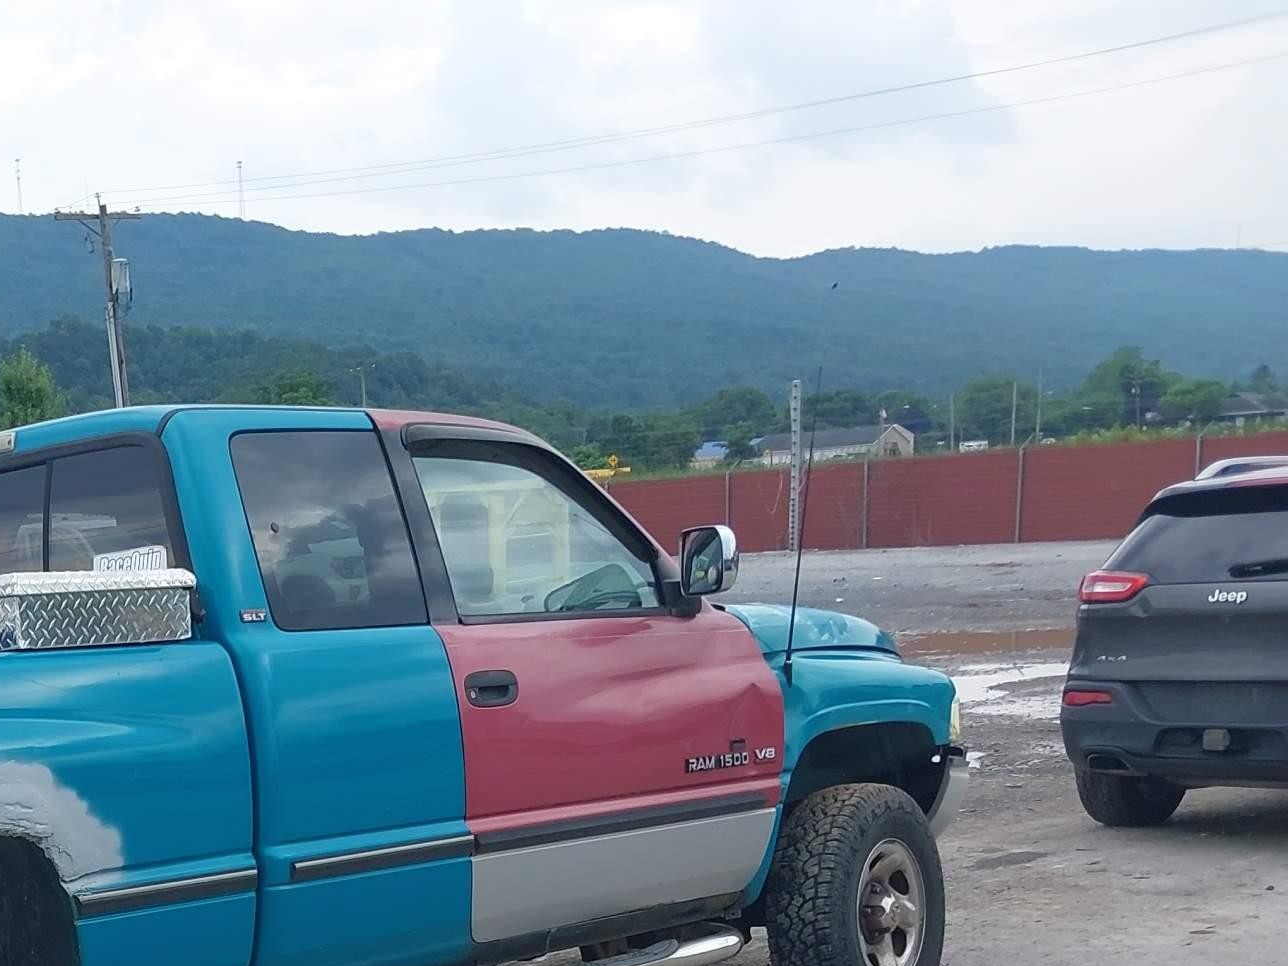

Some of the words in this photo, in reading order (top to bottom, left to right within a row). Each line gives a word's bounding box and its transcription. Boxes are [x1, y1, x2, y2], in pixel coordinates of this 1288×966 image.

[1208, 589, 1247, 604] Jeep
[243, 612, 267, 621] SLT
[688, 757, 716, 772] RAM
[720, 752, 750, 768] 1500
[755, 747, 776, 760] V8
